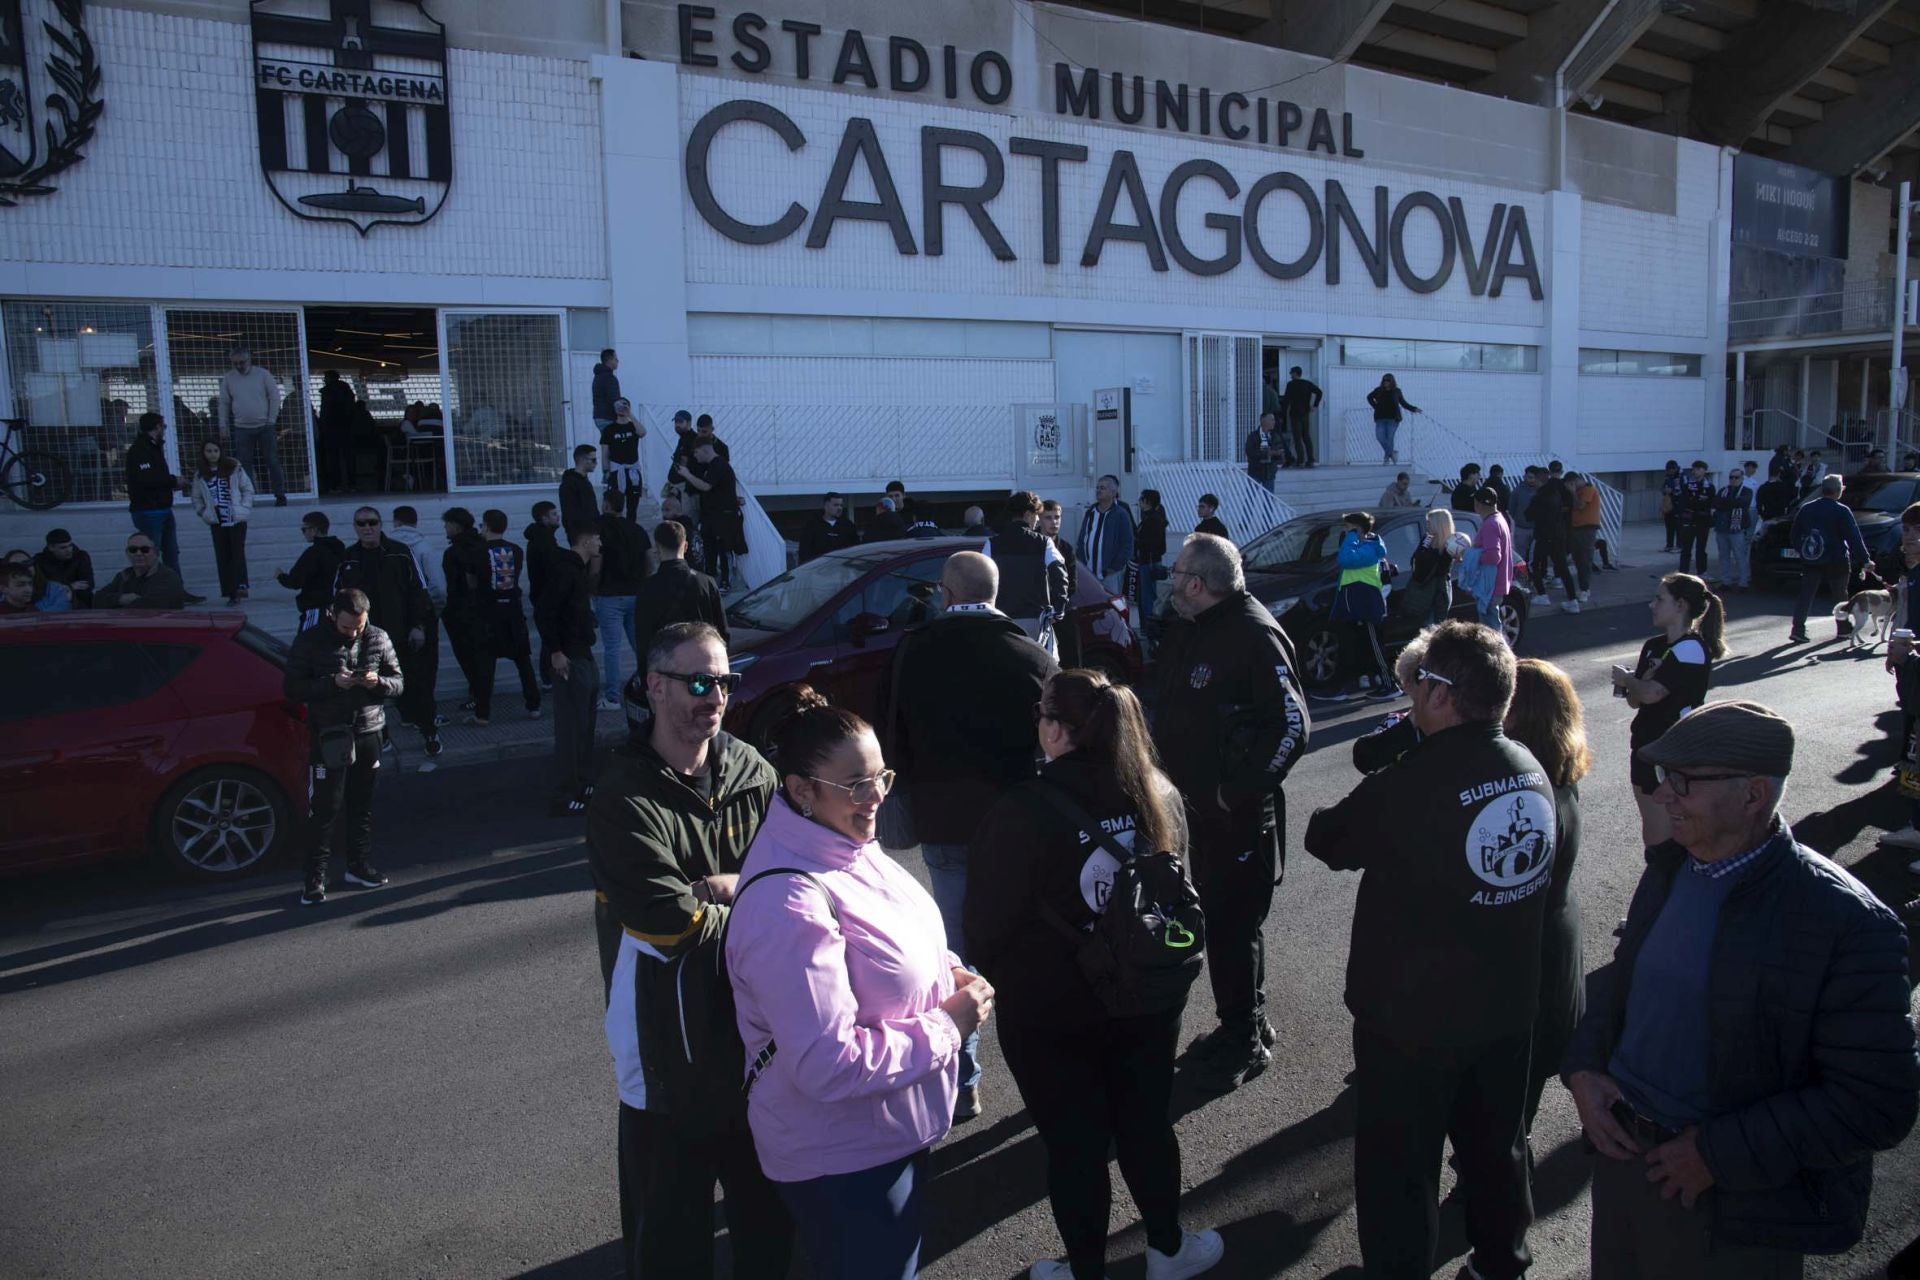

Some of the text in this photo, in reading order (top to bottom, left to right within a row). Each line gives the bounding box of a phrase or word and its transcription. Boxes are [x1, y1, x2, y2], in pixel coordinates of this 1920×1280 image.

[261, 64, 443, 101] FC CARTAGENA
[678, 3, 1365, 159] ESTADIO MUNICIPAL
[685, 98, 1545, 301] CARTAGONOVA
[1756, 182, 1781, 205] MIKI
[1264, 692, 1303, 773] CARTAGENA
[1459, 772, 1543, 807] SUBMARINO
[1469, 869, 1550, 905] ALBINEGRO
